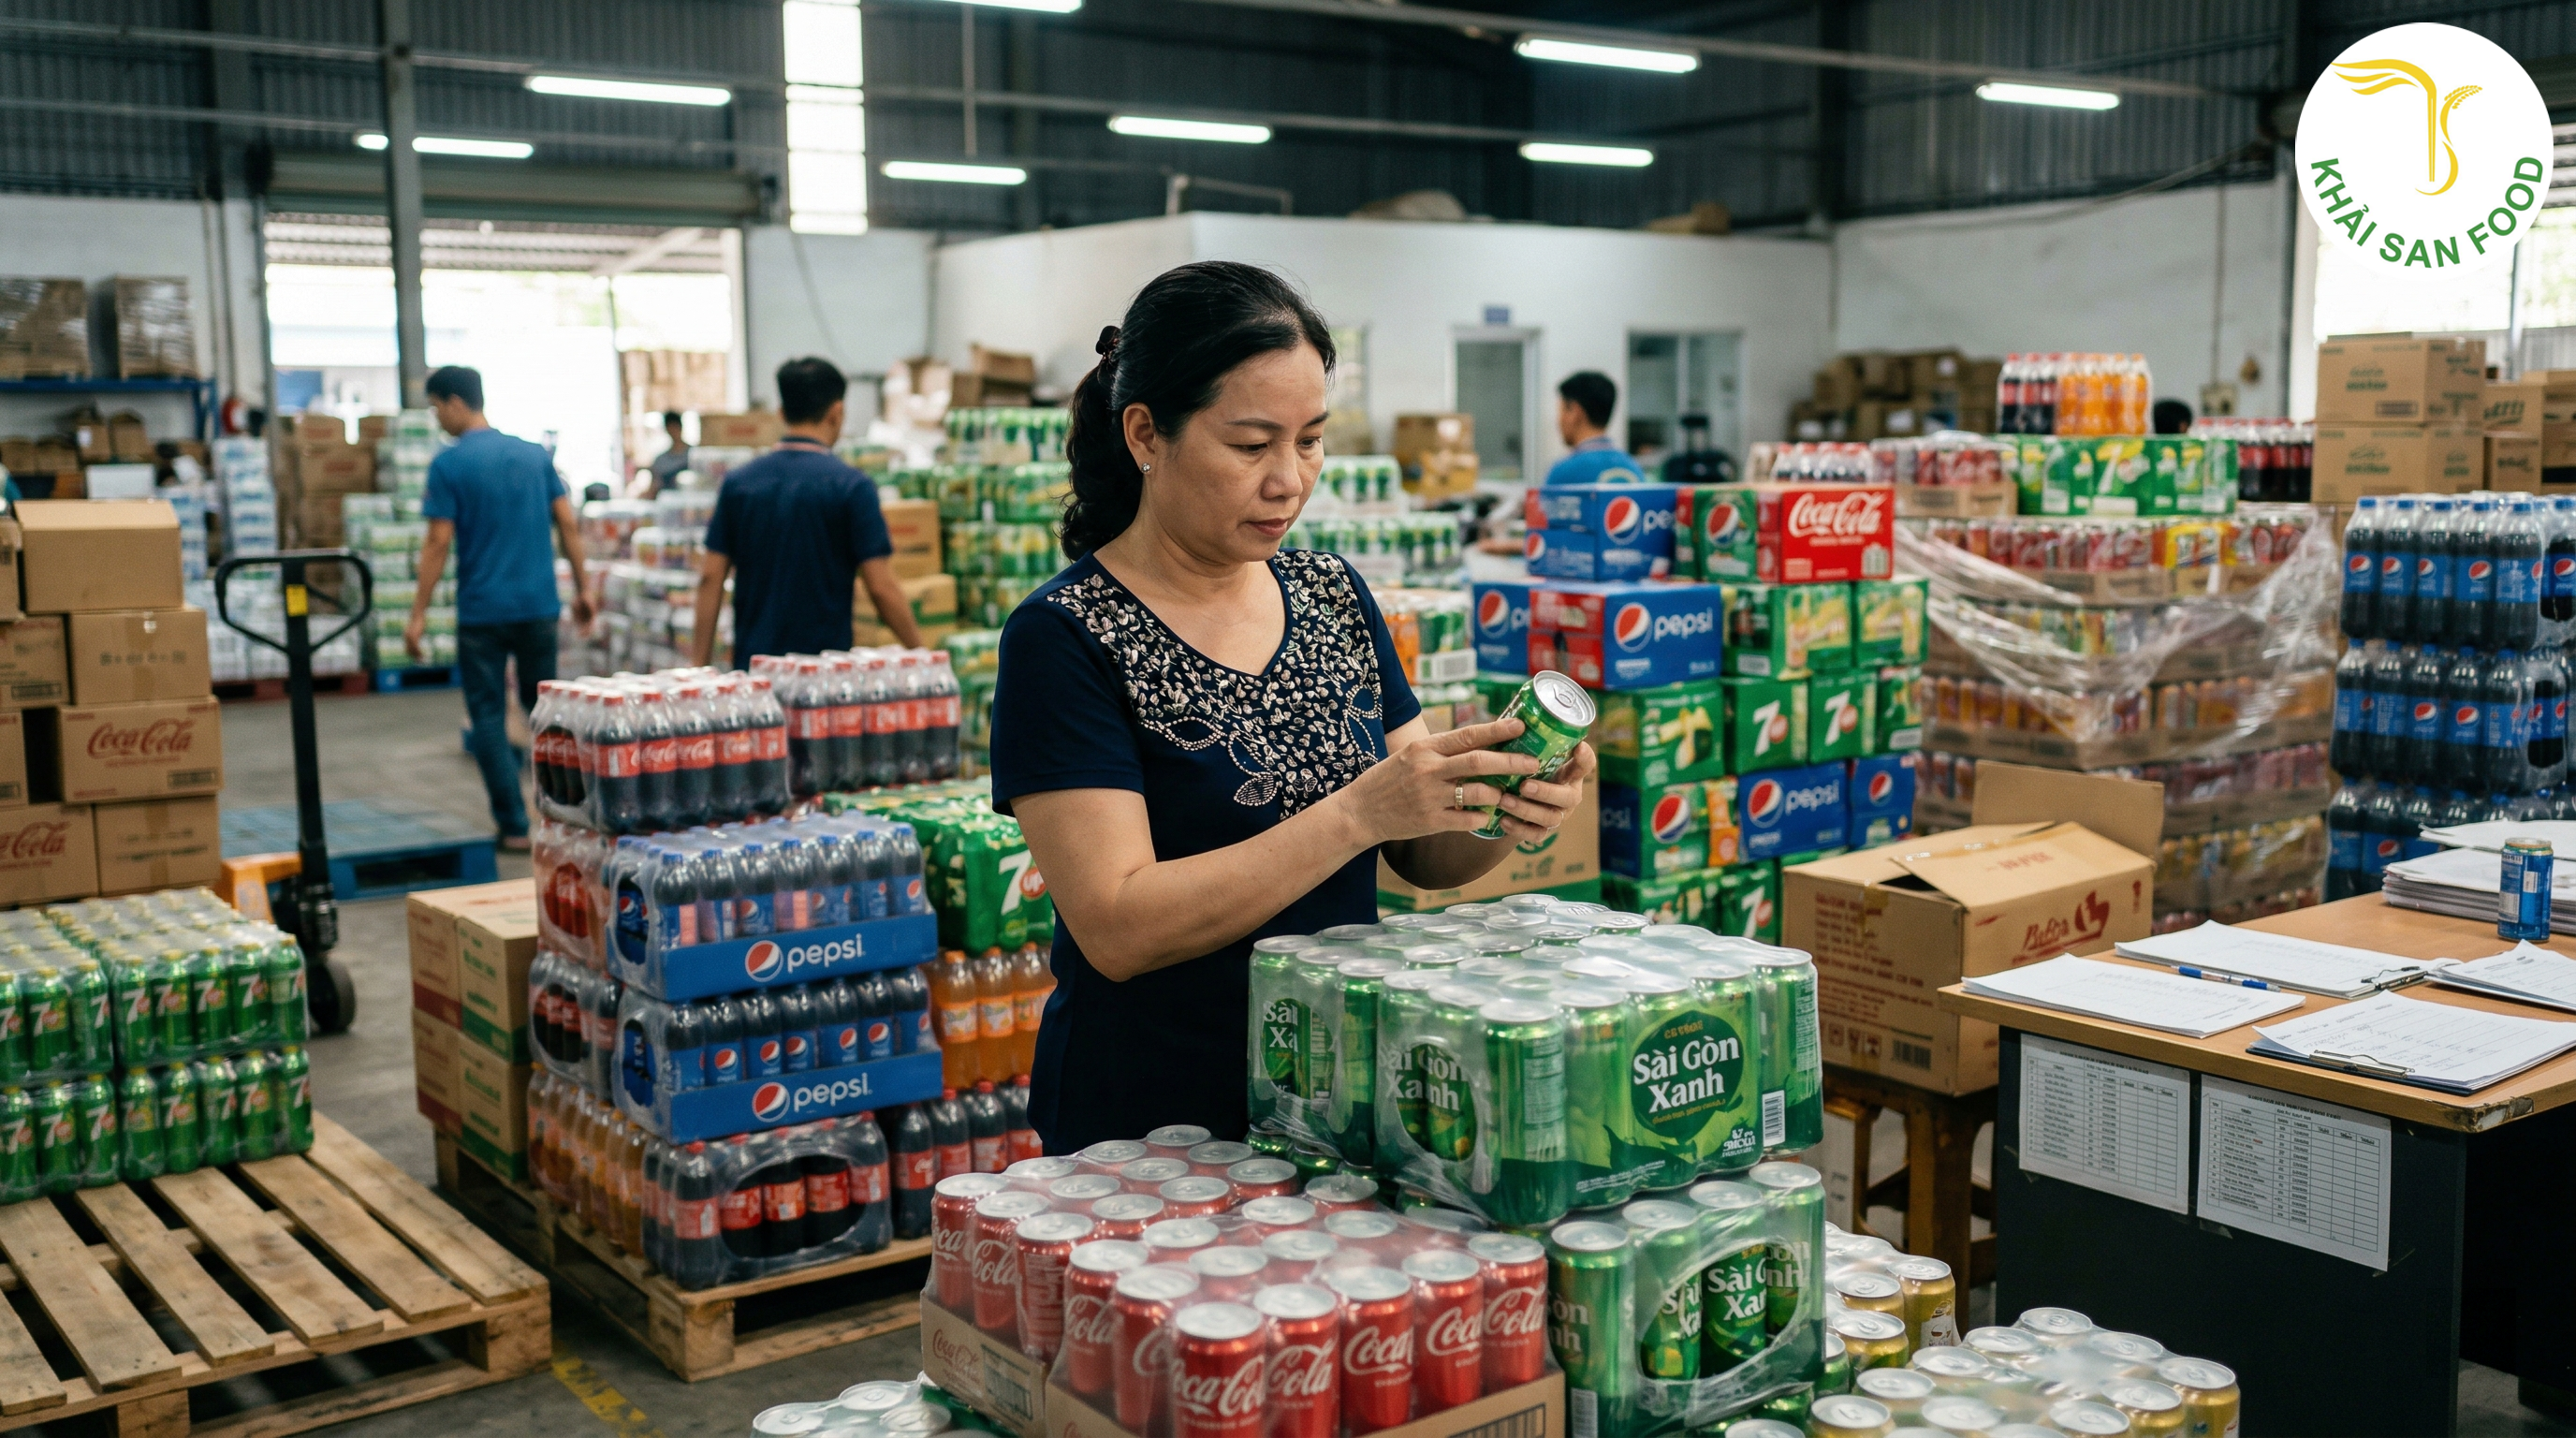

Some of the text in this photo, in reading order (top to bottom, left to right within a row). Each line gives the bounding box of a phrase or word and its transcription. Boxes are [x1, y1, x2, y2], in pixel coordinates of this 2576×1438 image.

[1654, 607, 1713, 642] pepsi
[1786, 779, 1839, 815] pepsi
[788, 933, 862, 973] pepsi
[1633, 1035, 1740, 1085] Sài Gòn
[795, 1073, 869, 1112] pepsi
[1648, 1067, 1725, 1114] Xanh
[1708, 1265, 1752, 1293] Sài
